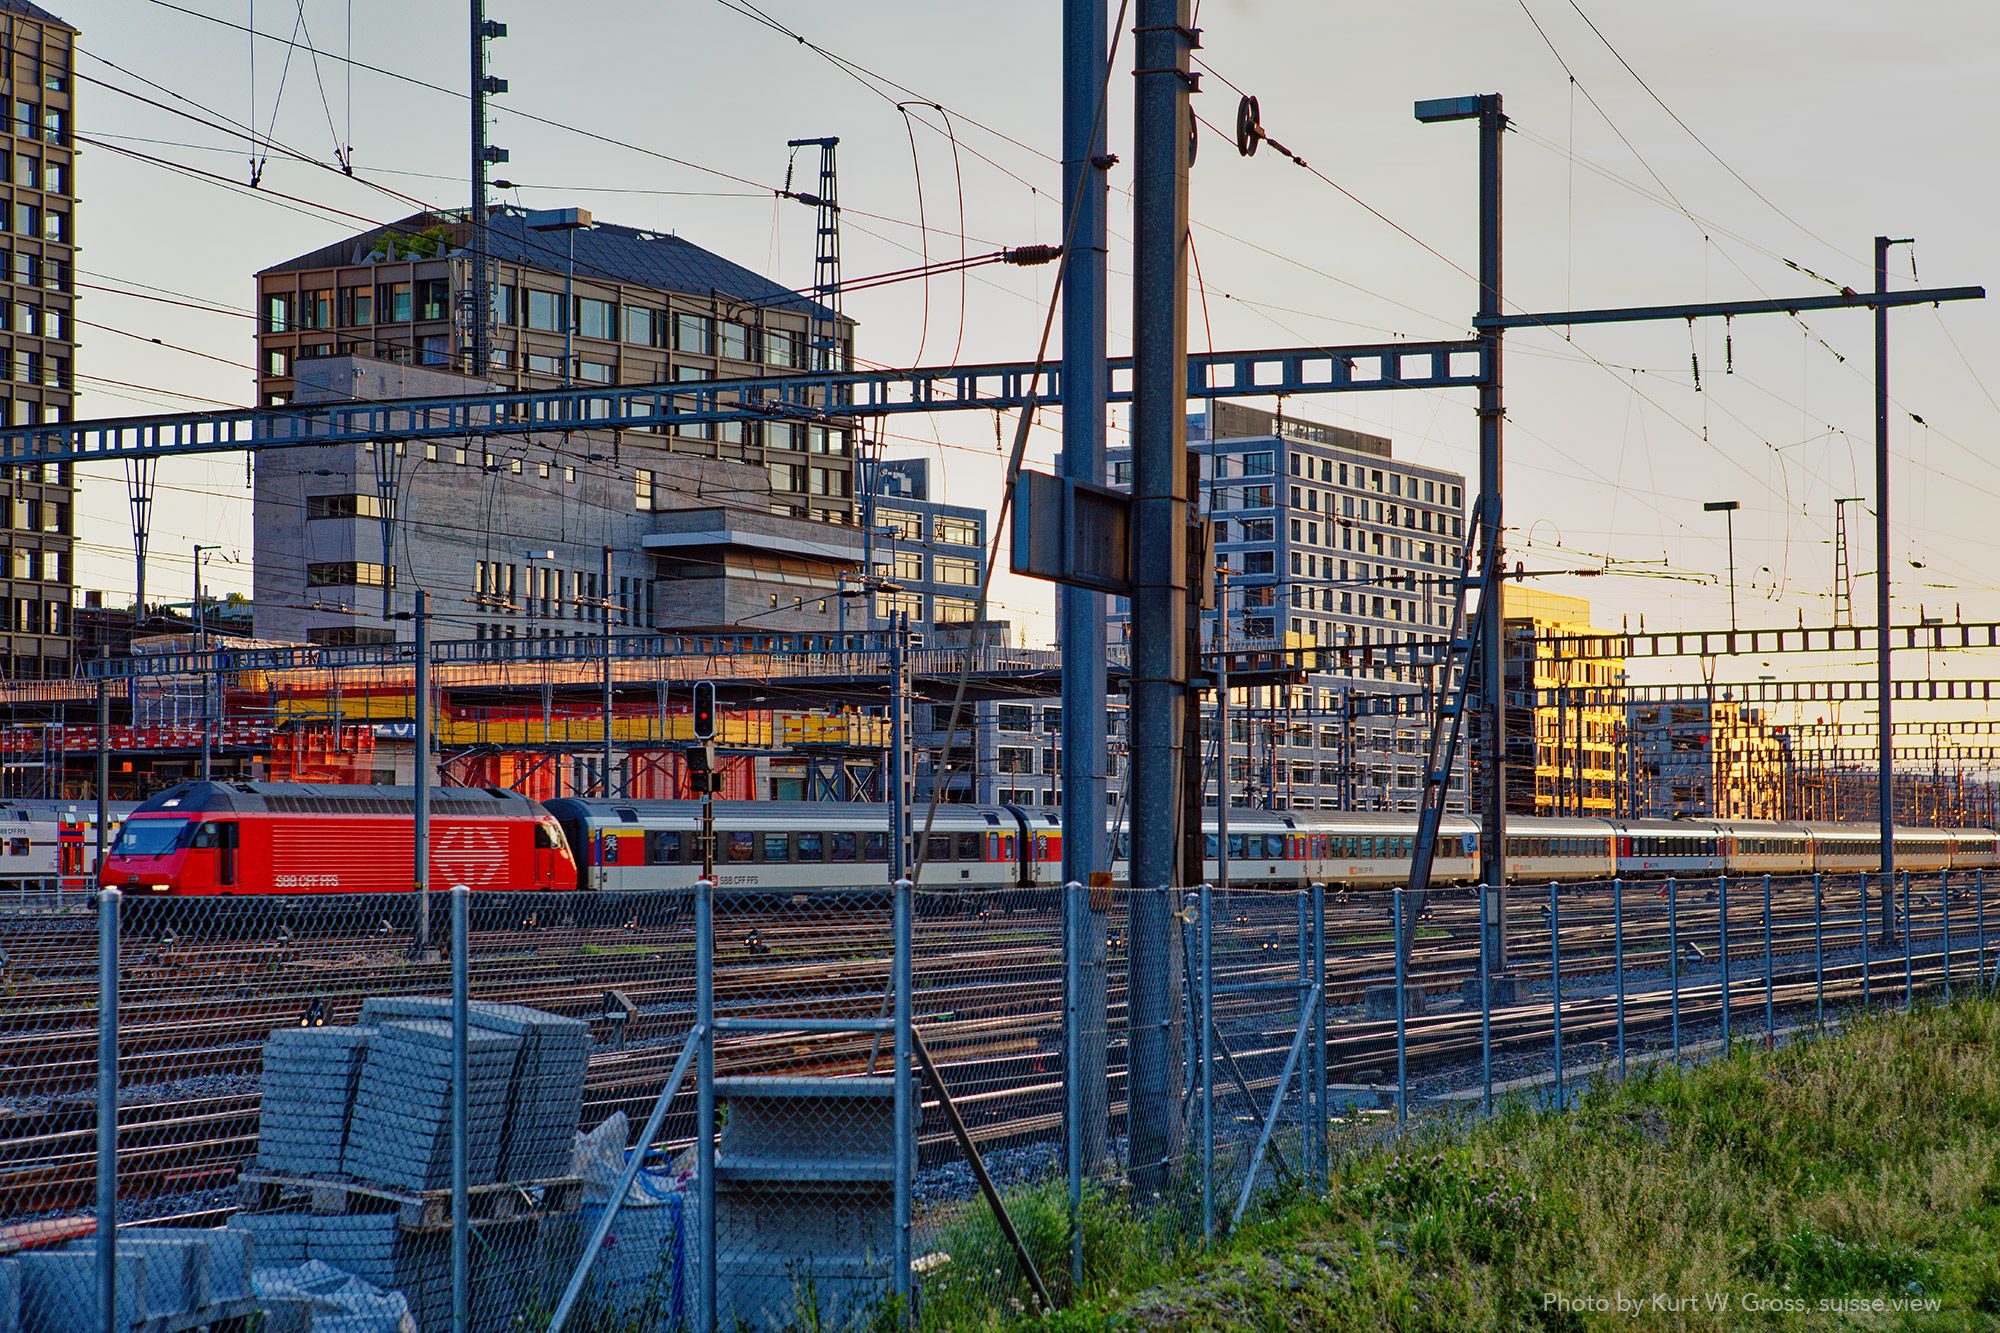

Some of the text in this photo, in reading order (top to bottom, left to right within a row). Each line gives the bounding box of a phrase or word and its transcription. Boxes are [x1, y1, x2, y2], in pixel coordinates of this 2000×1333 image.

[275, 874, 339, 887] SBB CFF FFS
[720, 875, 759, 885] SBB CFF FFS
